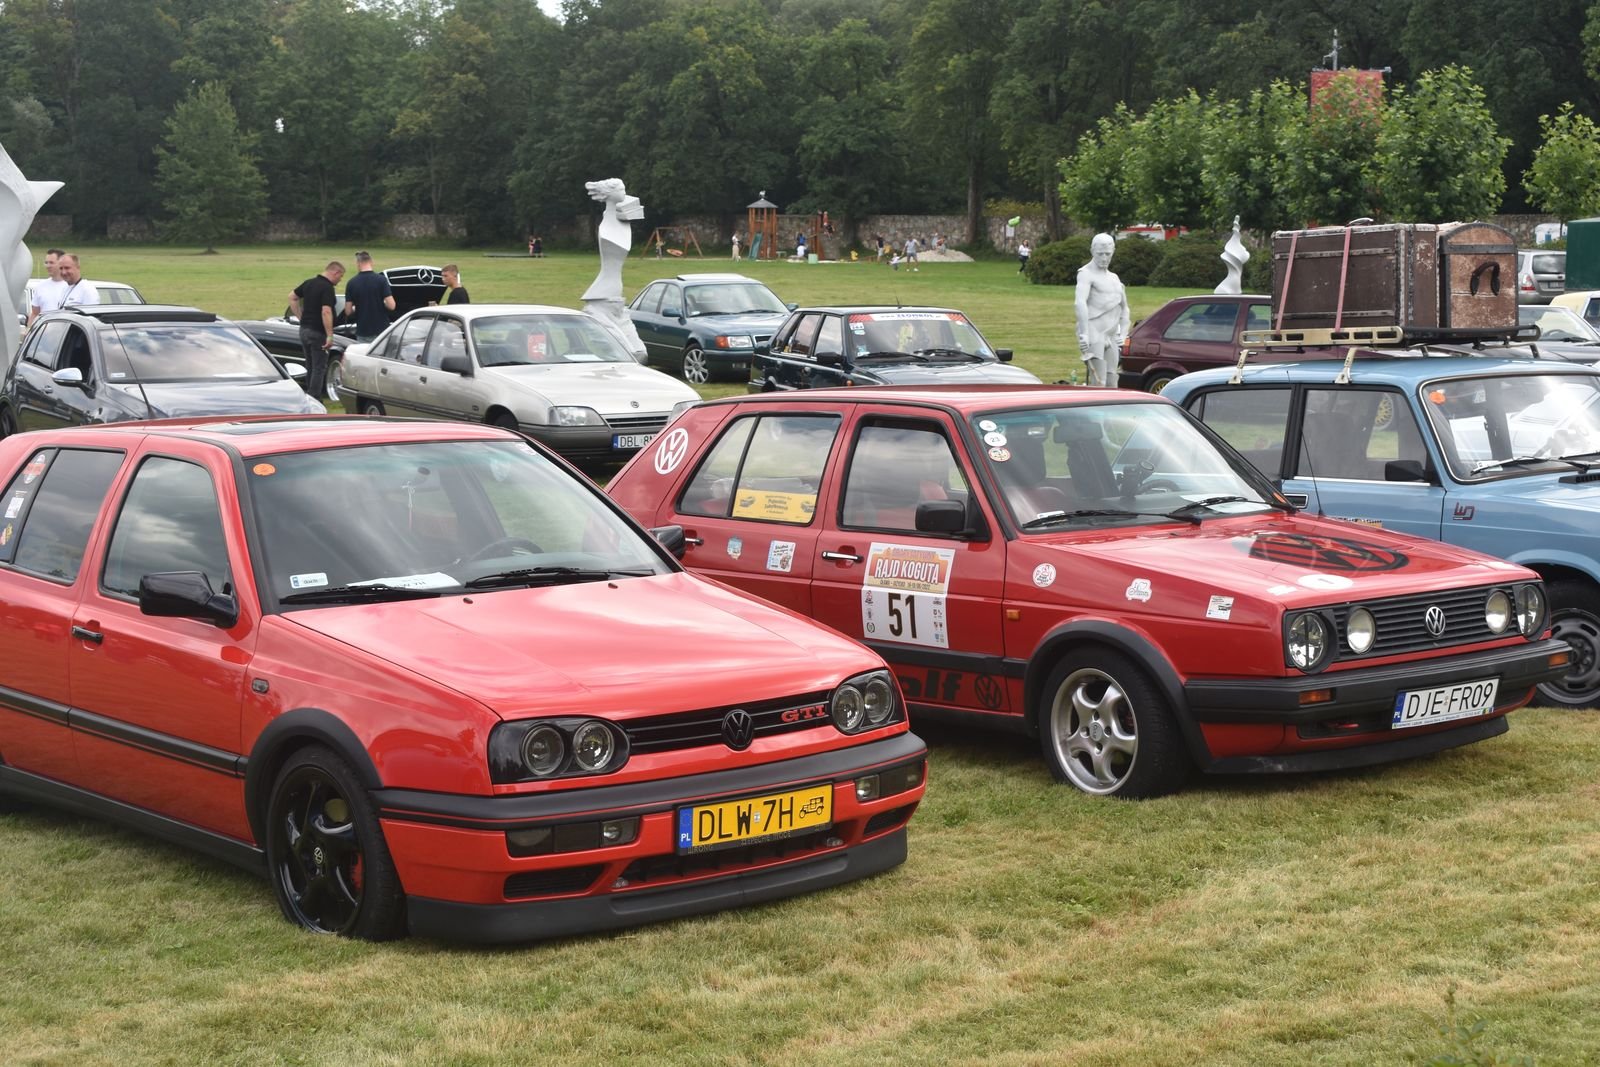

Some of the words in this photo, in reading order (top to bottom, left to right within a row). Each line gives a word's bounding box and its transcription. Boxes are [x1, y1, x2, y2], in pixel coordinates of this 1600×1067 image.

[620, 436, 640, 448] DBL
[874, 558, 900, 578] RAJD
[900, 560, 940, 585] KOGUTA
[887, 592, 918, 639] 51
[896, 669, 963, 702] olf
[1406, 690, 1445, 719] DJE
[1447, 682, 1494, 713] FR09
[781, 704, 826, 722] GTI
[698, 803, 752, 842] DLW
[763, 796, 794, 832] 7H
[680, 833, 691, 842] PL
